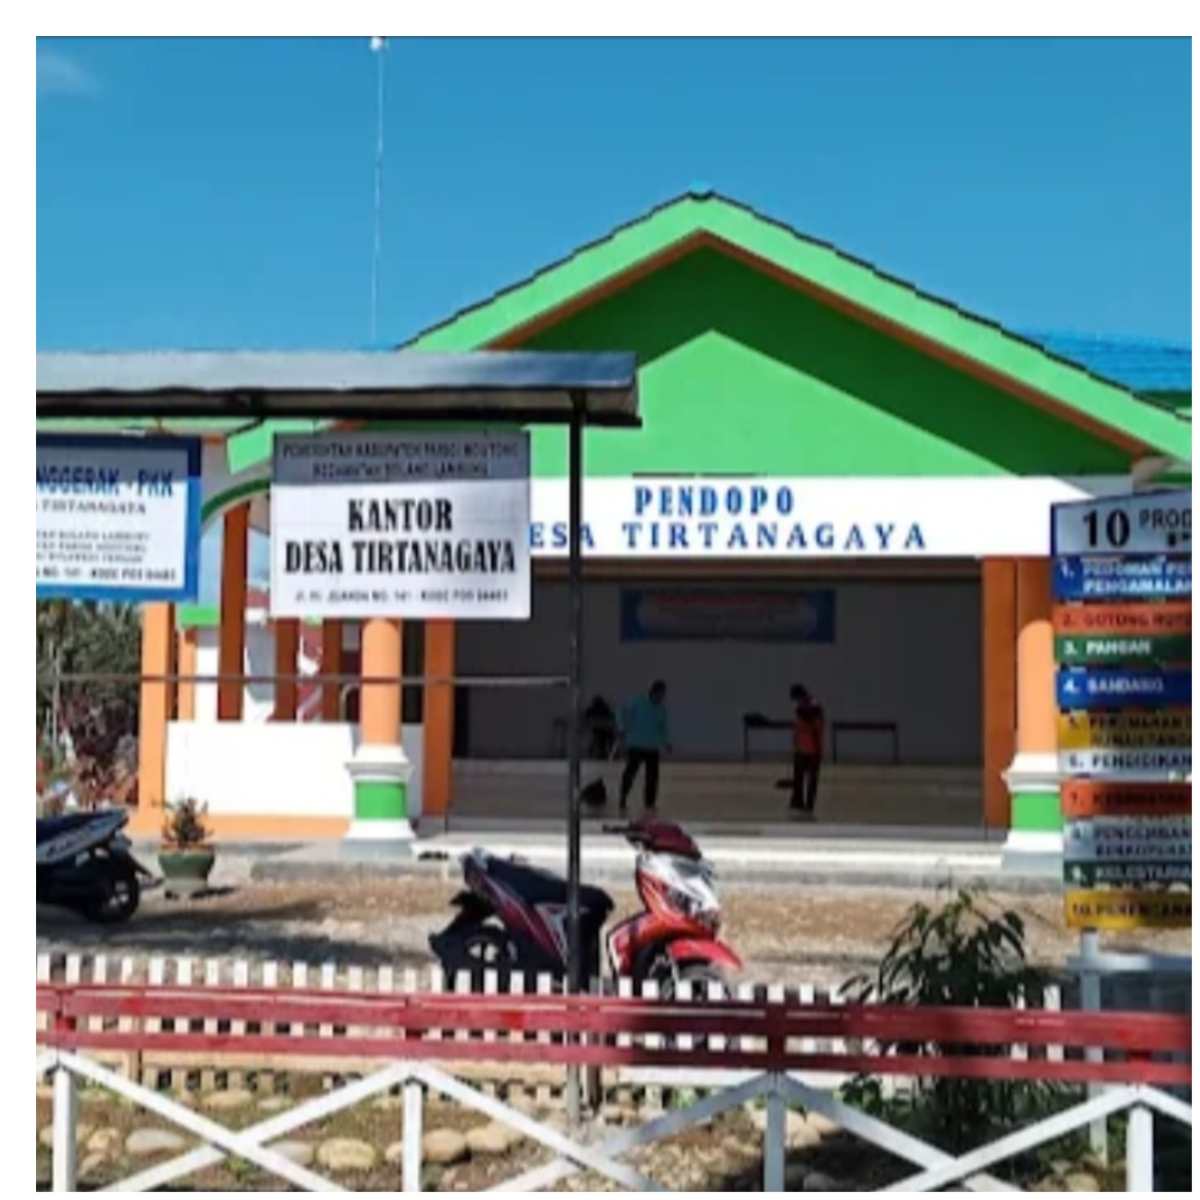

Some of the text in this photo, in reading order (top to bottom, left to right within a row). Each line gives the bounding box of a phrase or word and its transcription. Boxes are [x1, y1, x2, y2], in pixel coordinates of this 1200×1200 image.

[137, 468, 174, 497] PKK
[347, 498, 454, 533] KANTOR
[634, 485, 794, 517] PENDOPO
[528, 521, 926, 550] ESA TIRTANAGAYA
[1083, 509, 1130, 547] 10
[285, 540, 516, 574] DESA TIRTANAGAYA
[1086, 640, 1152, 656] PANGAN
[1062, 677, 1165, 695] 4. SANDANG
